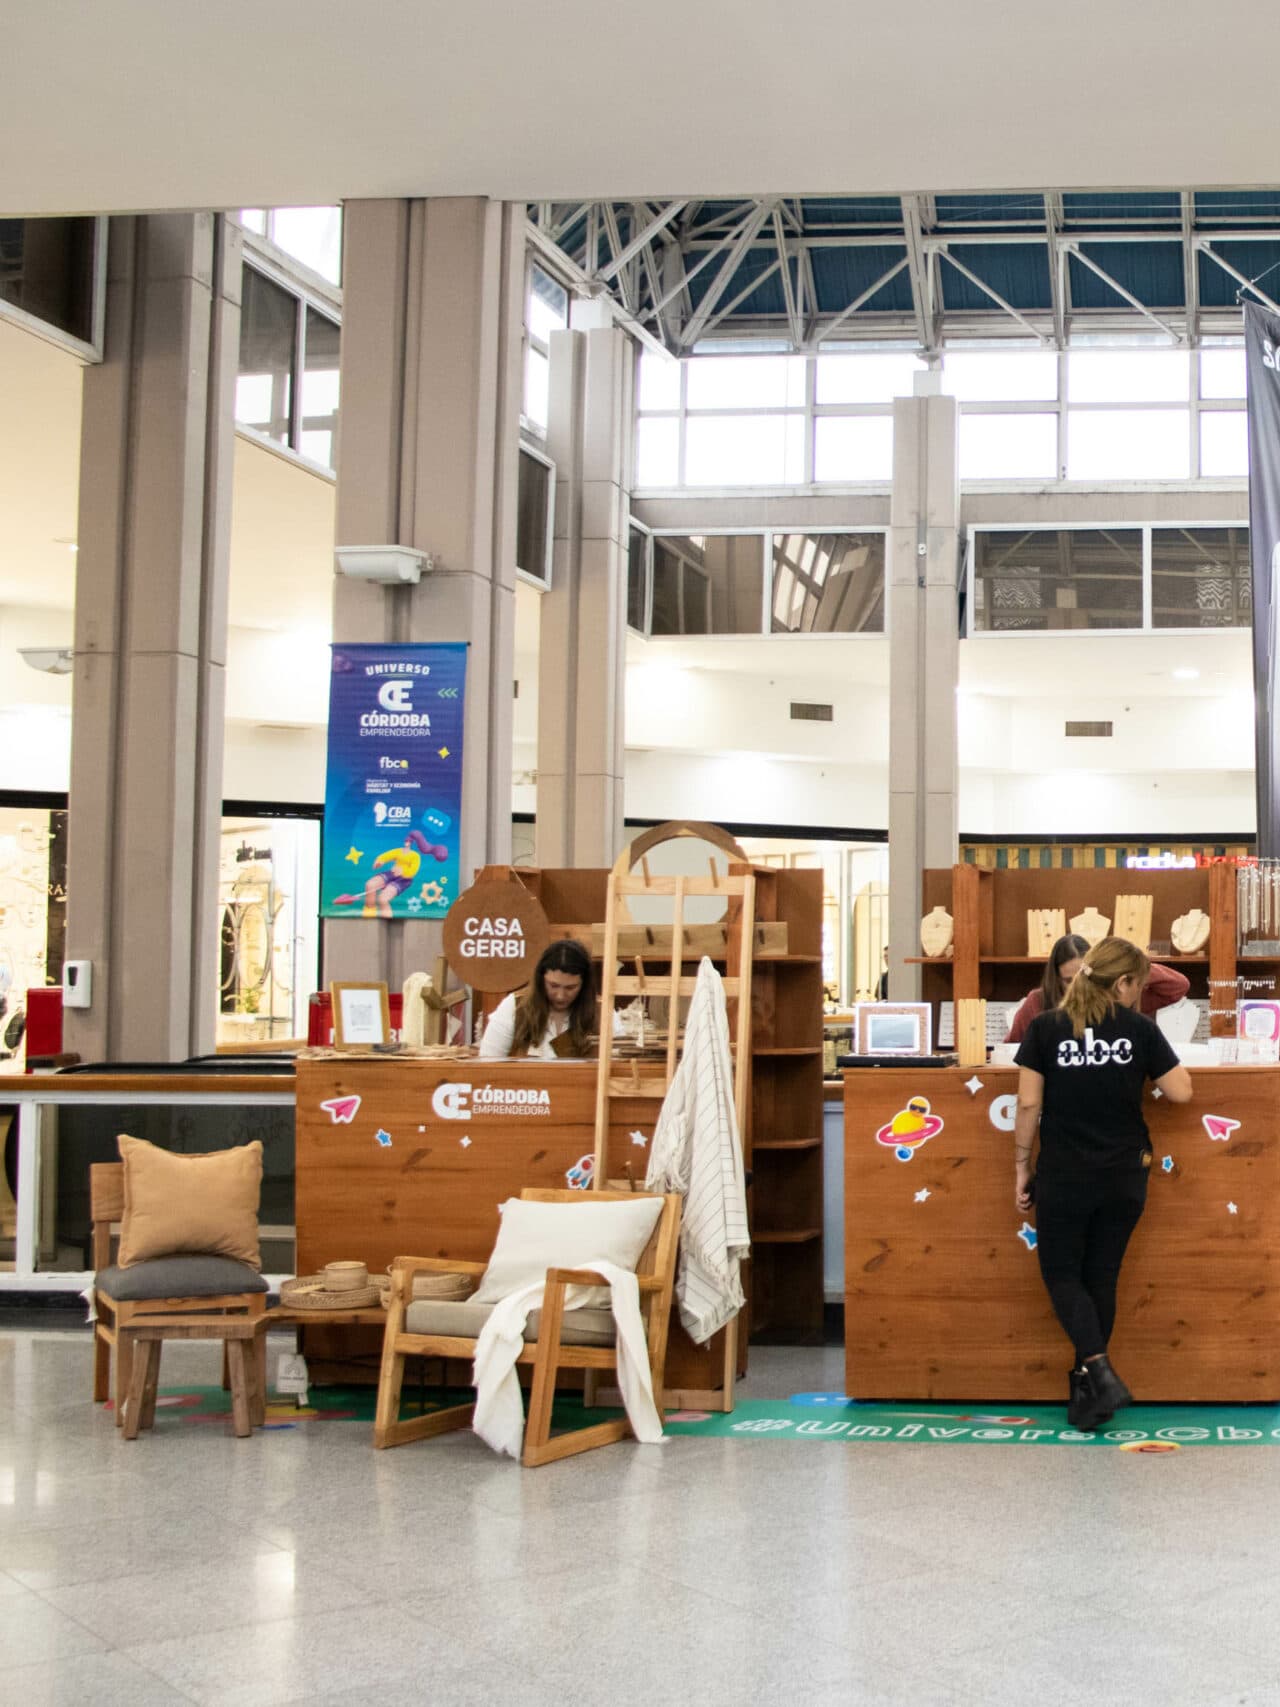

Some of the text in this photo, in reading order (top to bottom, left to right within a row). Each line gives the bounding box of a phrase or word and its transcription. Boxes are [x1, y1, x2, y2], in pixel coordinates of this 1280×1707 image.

[365, 663, 431, 676] UNIVERSO
[360, 711, 431, 727] CÓRDOBA
[360, 727, 431, 737] EMPRENDEDORA
[388, 806, 412, 818] CBA
[464, 917, 523, 936] CASA
[460, 939, 525, 958] GERBI
[1057, 1027, 1133, 1067] abc
[472, 1084, 550, 1104] CÓRDOBA
[472, 1104, 550, 1115] EMPRENDEDORA
